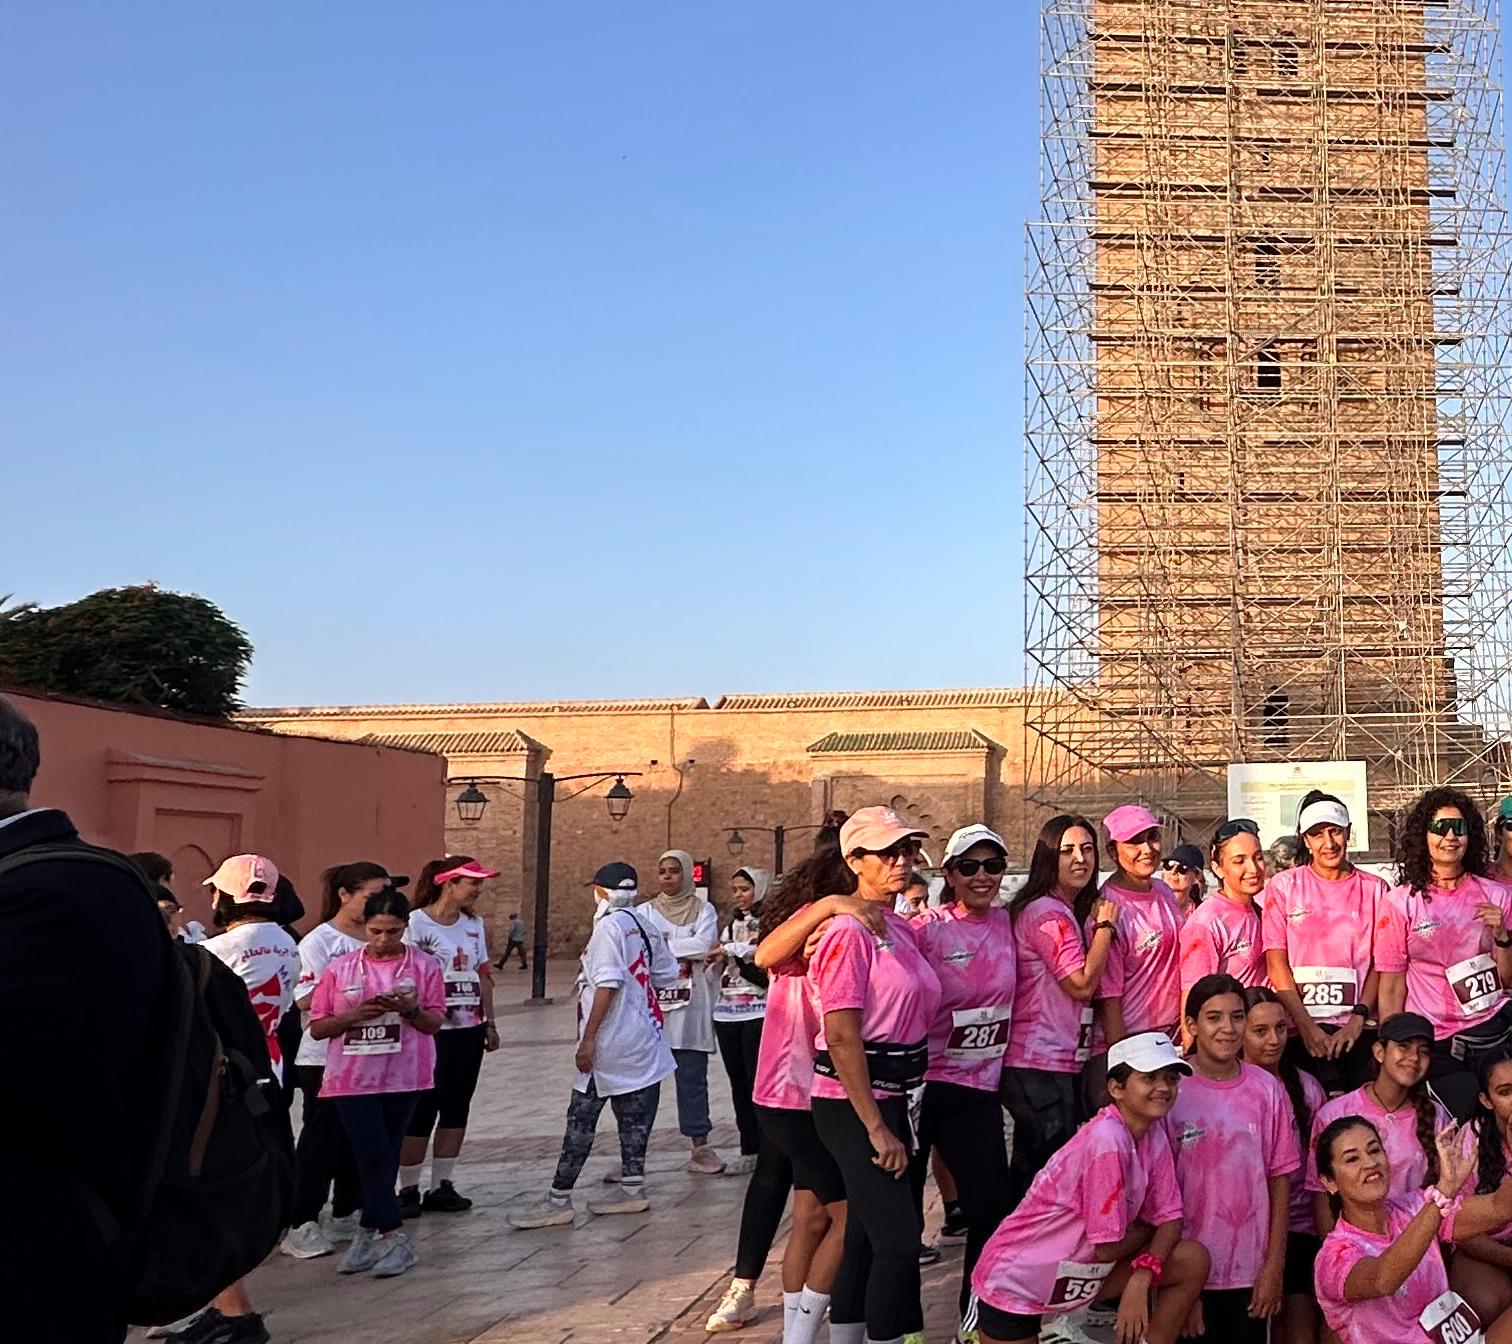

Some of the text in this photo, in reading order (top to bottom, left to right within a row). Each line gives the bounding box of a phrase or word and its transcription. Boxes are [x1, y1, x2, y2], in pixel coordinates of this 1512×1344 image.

[1302, 983, 1343, 1005] 285
[1465, 971, 1496, 999] 279
[361, 1026, 386, 1040] 109
[960, 1023, 1000, 1048] 287
[1064, 1278, 1103, 1301] 59
